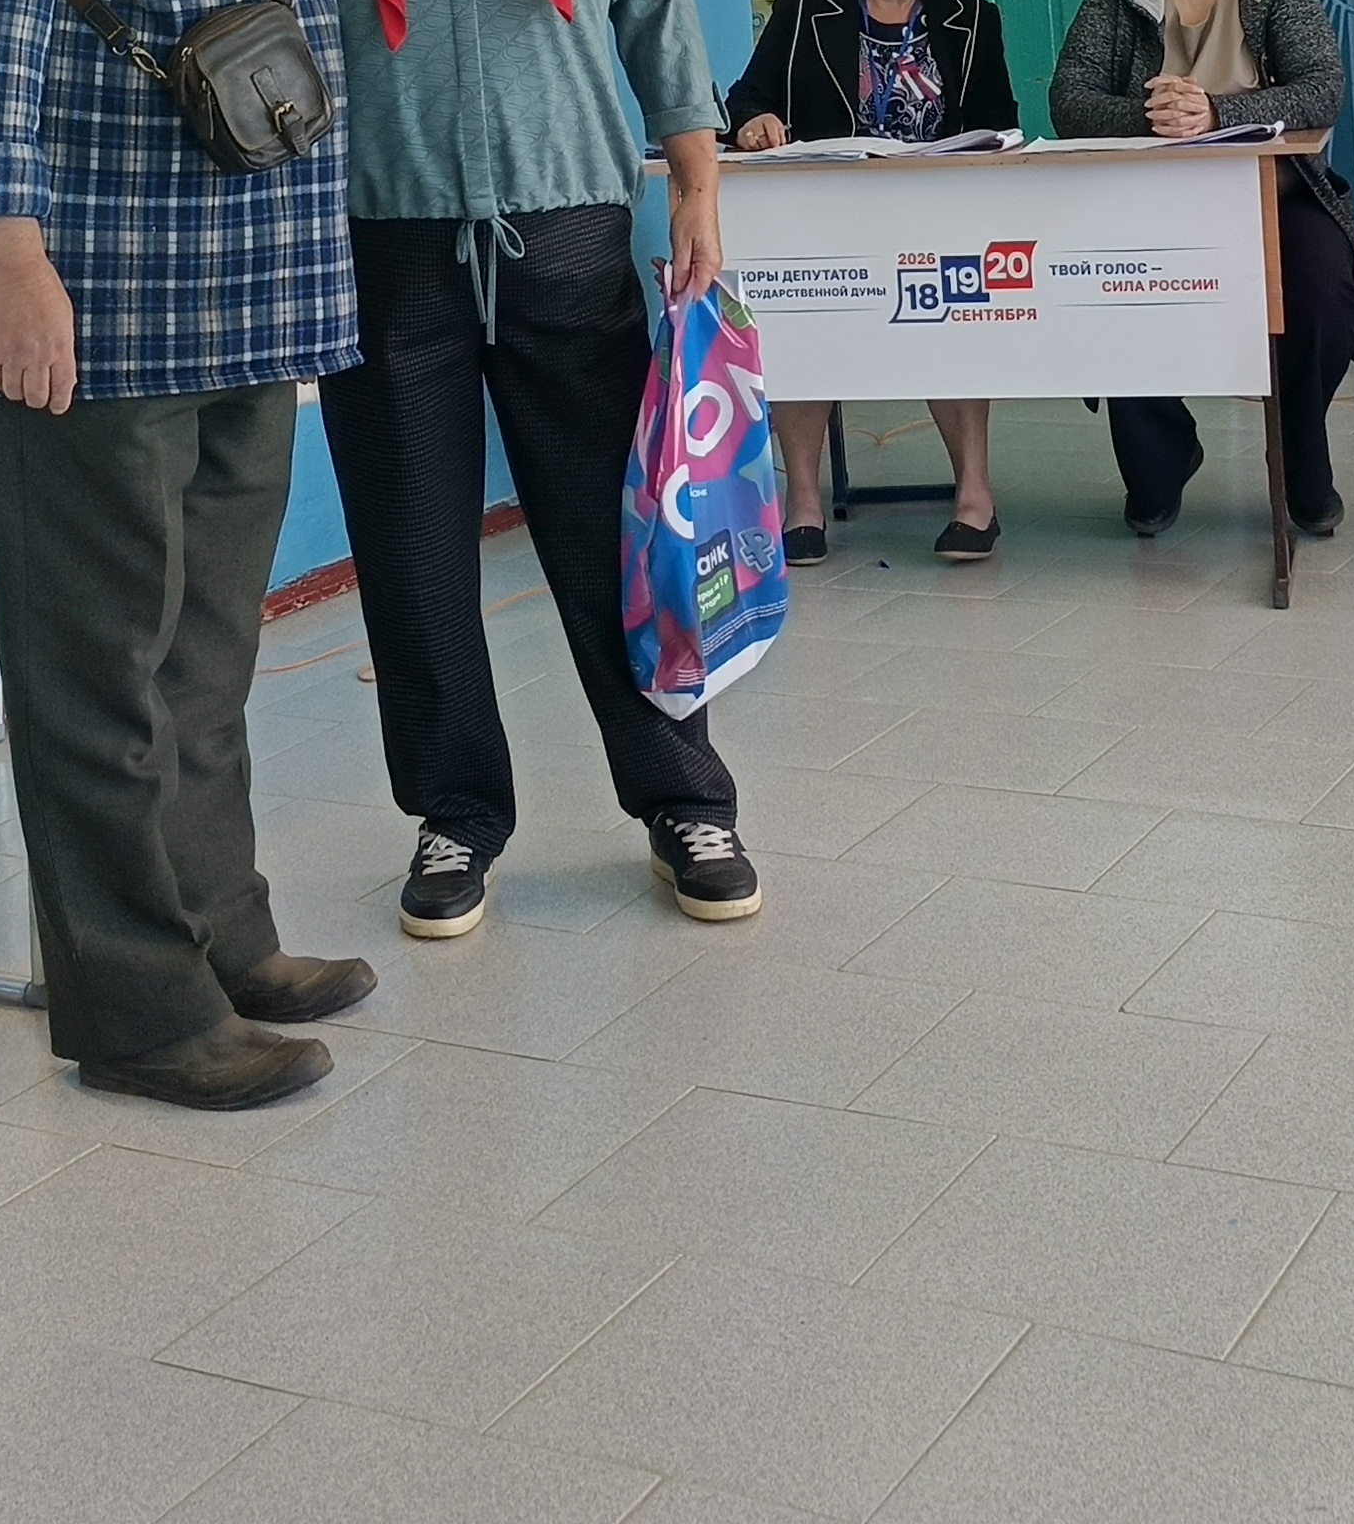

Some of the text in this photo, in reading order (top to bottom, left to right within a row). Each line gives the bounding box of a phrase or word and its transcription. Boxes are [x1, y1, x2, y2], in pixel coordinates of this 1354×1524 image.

[897, 252, 936, 265] 2026
[741, 268, 869, 283] БОРЫ ДЕПУТАТОВ
[1048, 261, 1091, 276] ТВОЙ
[1095, 262, 1148, 275] ГОЛОС
[905, 251, 1029, 310] 18 19 20
[1101, 279, 1219, 292] СИЛА РОССИИ!
[745, 285, 887, 300] СУДАРСТВЕННОЙ ДУМЫ
[951, 308, 1037, 322] СЕНТЯБРЯ
[696, 541, 730, 576] анк
